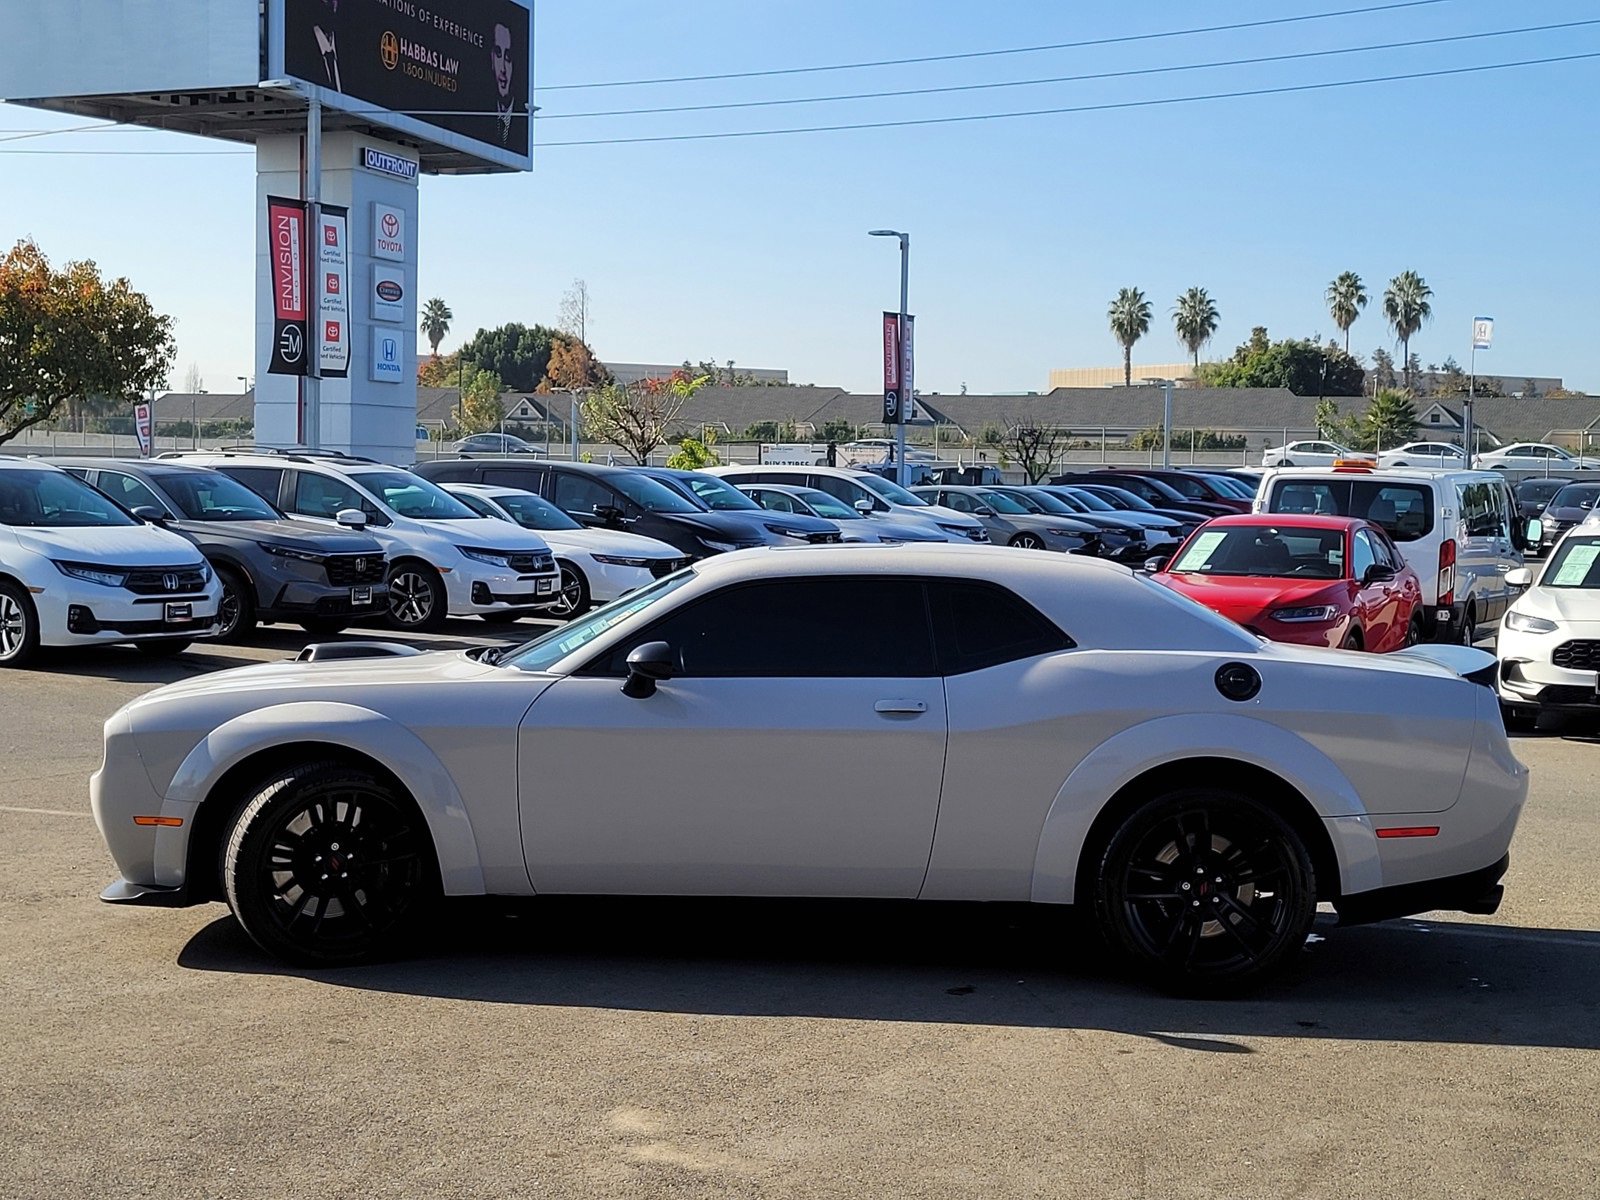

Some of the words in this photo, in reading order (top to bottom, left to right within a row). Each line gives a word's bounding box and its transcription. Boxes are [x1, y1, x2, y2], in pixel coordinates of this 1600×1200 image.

[377, 0, 415, 17] ATIONS
[419, 9, 431, 23] OF
[433, 15, 484, 48] EXPERIENCE
[400, 38, 438, 68] HABBAS
[440, 54, 459, 75] LAW
[368, 151, 415, 176] OUTFRONT
[378, 239, 403, 253] TOYOTA
[278, 215, 293, 310] ENVISION
[323, 297, 342, 305] Certified
[377, 363, 401, 372] HONDA
